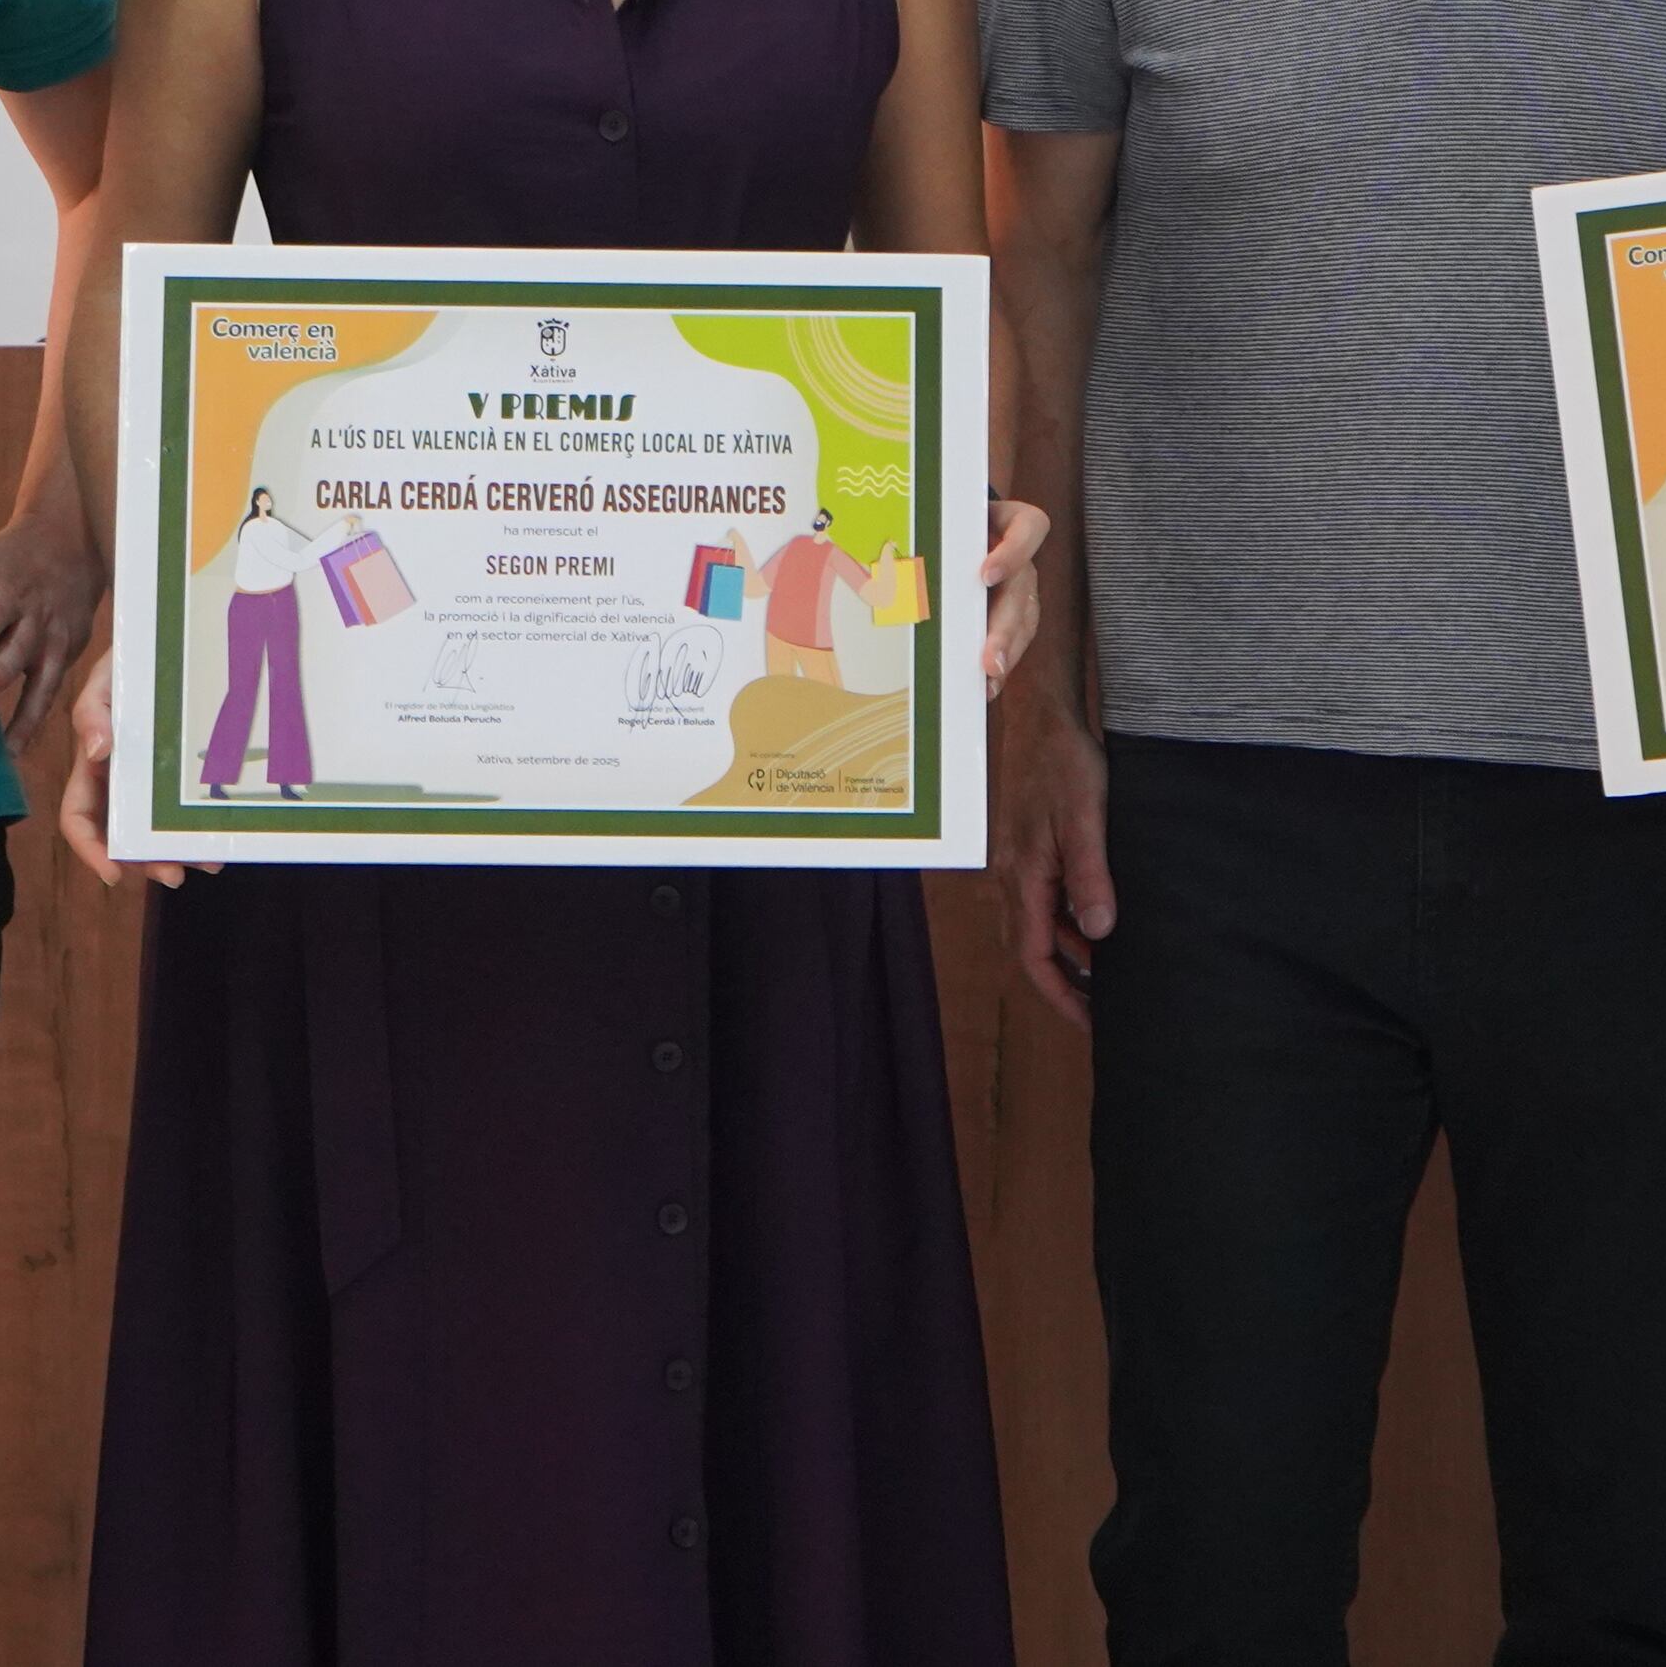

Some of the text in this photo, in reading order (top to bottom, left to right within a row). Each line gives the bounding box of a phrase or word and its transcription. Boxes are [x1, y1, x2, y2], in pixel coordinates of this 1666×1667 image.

[213, 318, 333, 342] Comerç en
[249, 341, 336, 360] valencià
[531, 365, 576, 377] Xàtiva
[468, 393, 637, 421] V PREMIS
[312, 425, 792, 458] A L'ÚS DEL VALENCIÀ EN EL COMERÇ LOCAL DE XÀTIVA
[316, 474, 786, 514] CARLA CERDÁ CERVERÓ ASSEGURANCES
[504, 526, 598, 537] ha merescut el
[486, 556, 614, 576] SEGON PREMI
[455, 595, 481, 603] com
[486, 596, 492, 604] a
[498, 595, 591, 605] reconeixement
[597, 597, 617, 607] per
[425, 611, 675, 626] la promoció i la dignificació del valencià
[447, 632, 463, 640] en
[467, 630, 478, 640] el
[482, 632, 521, 641] sector
[525, 631, 586, 641] comercial
[591, 632, 607, 642] de
[429, 715, 460, 723] Boluda
[684, 718, 715, 726] Boluda
[517, 756, 571, 765] setembre
[575, 756, 589, 765] de
[593, 759, 620, 768] 2025
[776, 769, 825, 780] Diputació
[776, 784, 789, 792] de
